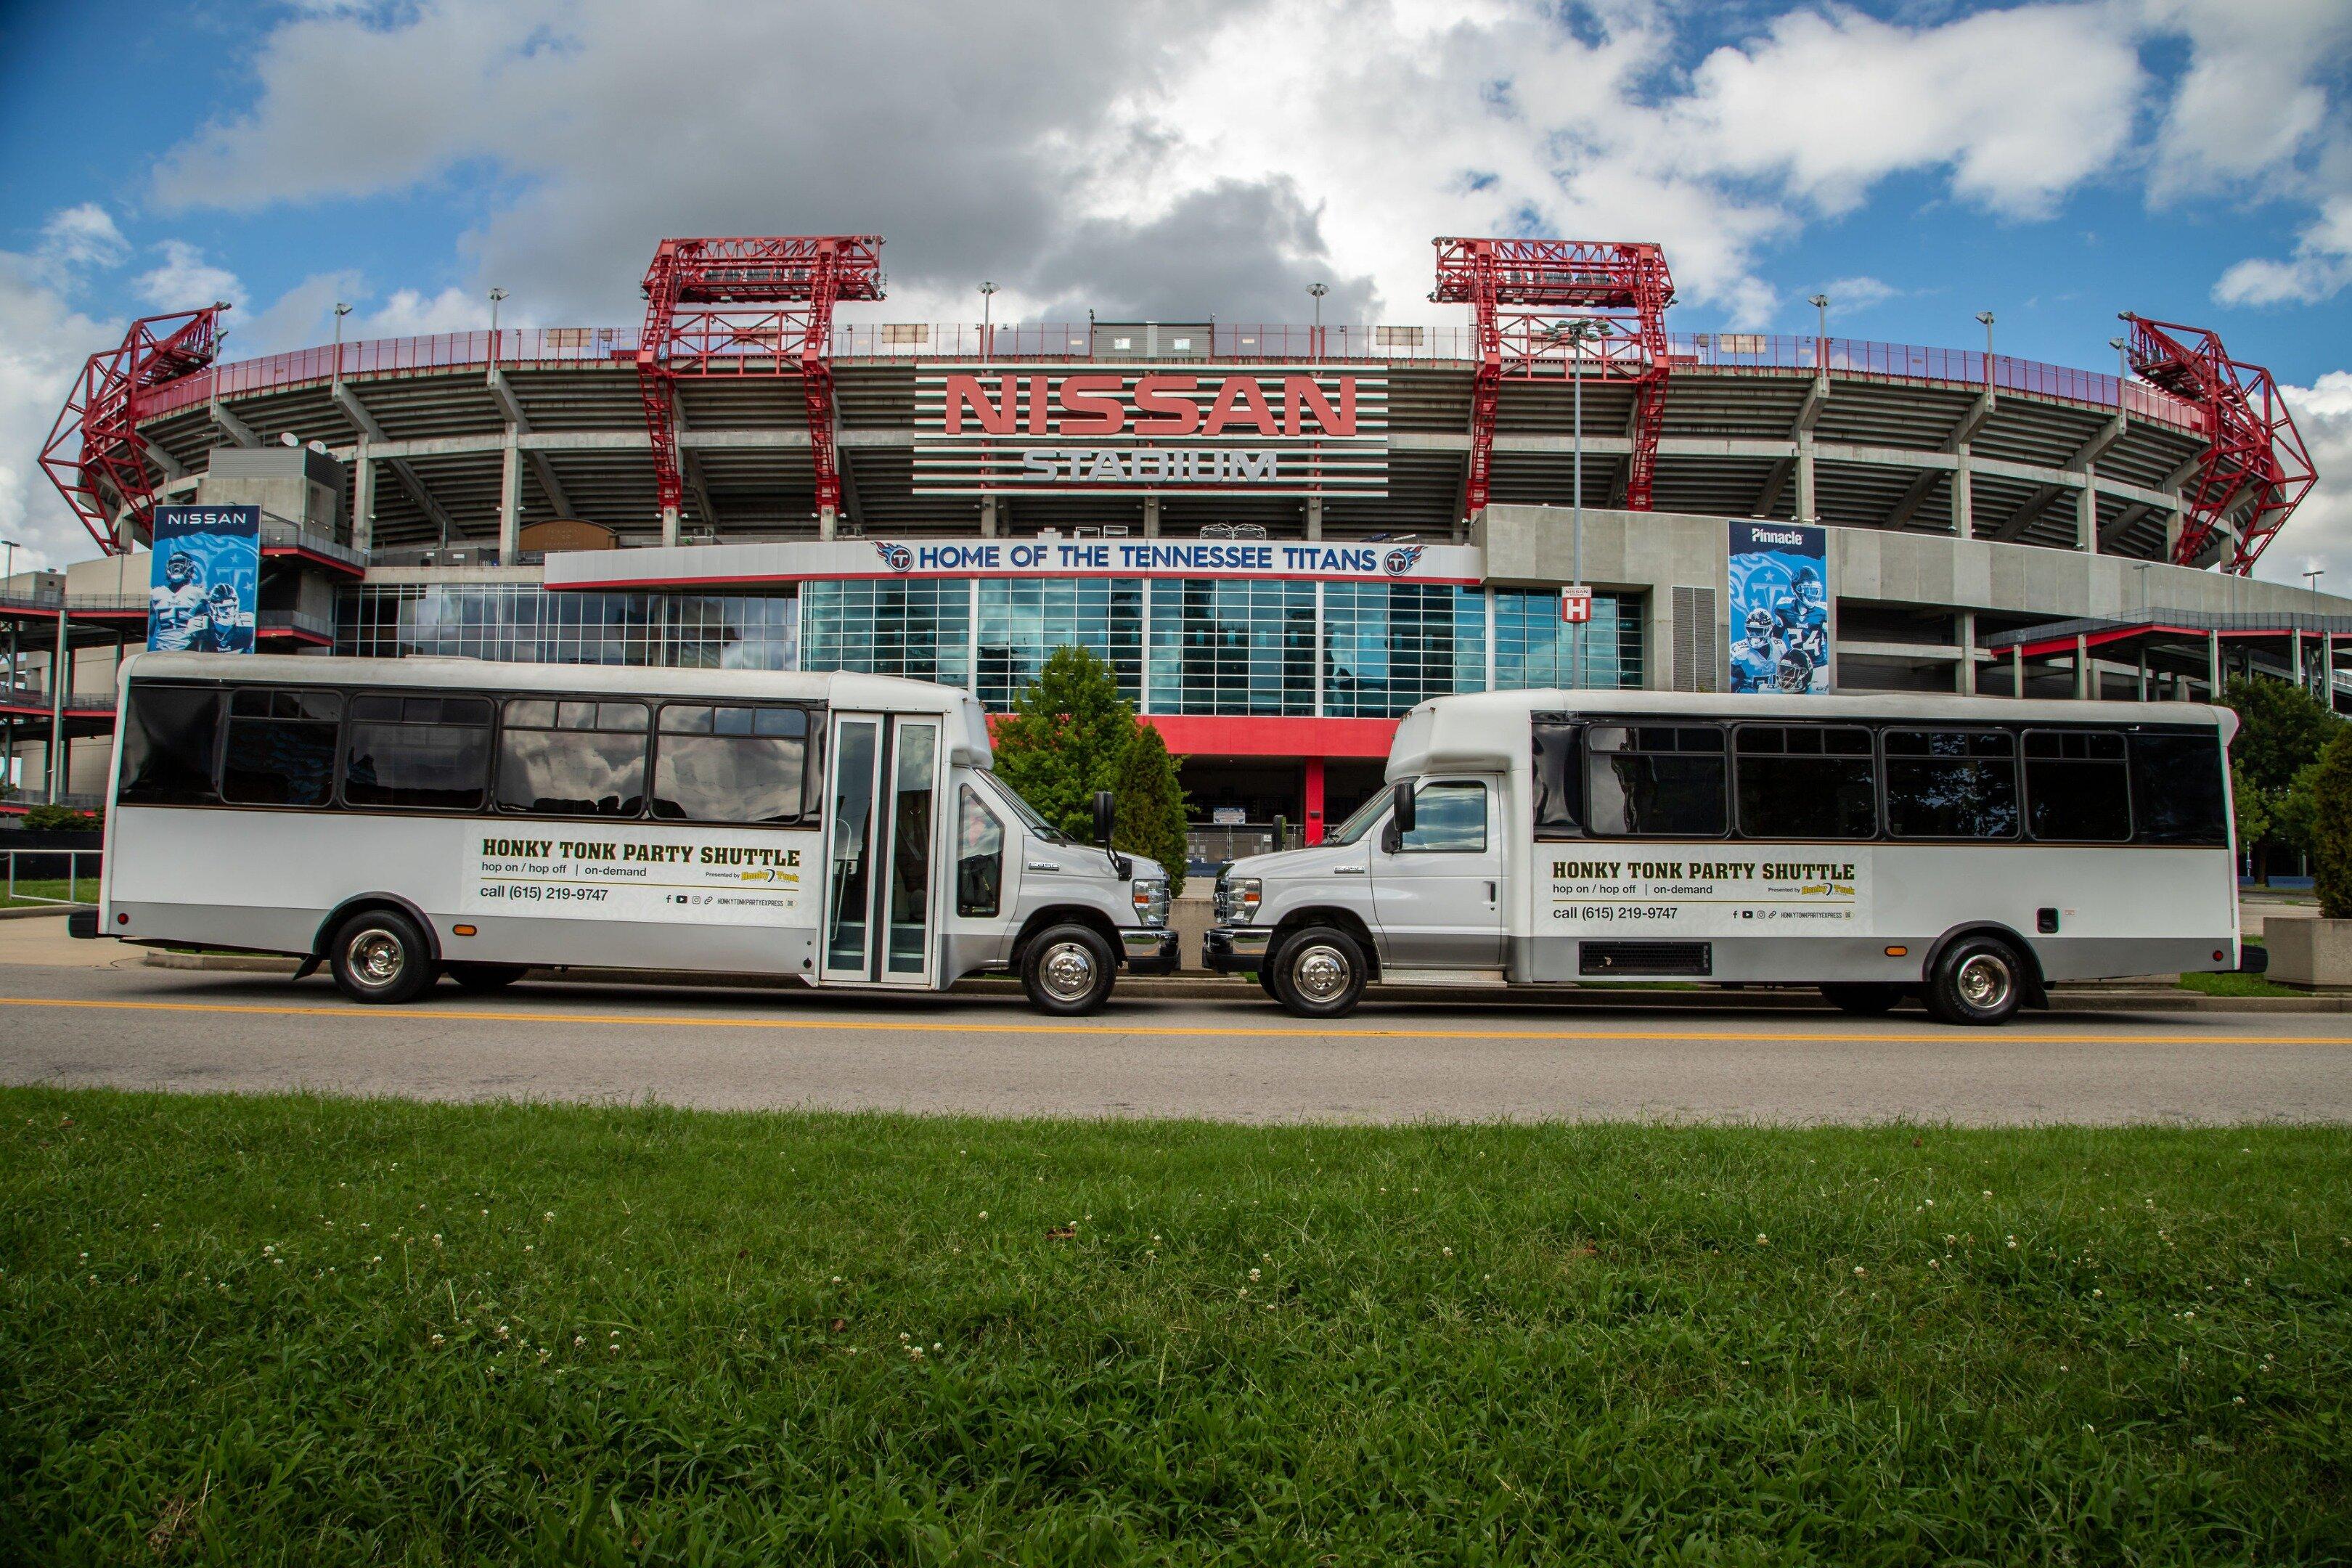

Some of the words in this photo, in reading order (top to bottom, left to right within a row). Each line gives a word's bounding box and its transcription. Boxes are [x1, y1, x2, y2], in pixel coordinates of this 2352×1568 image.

[946, 375, 1357, 436] NISSAN
[1021, 449, 1277, 483] STADIUM
[168, 513, 247, 525] NISSAN
[1752, 528, 1802, 546] Pinnacle
[919, 546, 1000, 568] HOME
[1010, 545, 1048, 568] OF
[1058, 545, 1109, 567] THE
[1120, 546, 1273, 568] TENNESSEE
[1283, 547, 1377, 571] TITANS
[1567, 599, 1587, 620] H
[1787, 627, 1821, 656] 24
[482, 838, 553, 858] HONKY
[559, 841, 617, 860] TONK
[623, 844, 694, 862] PARTY
[701, 846, 801, 867] SHUTTLE
[481, 862, 502, 872] hop
[528, 863, 549, 873] hop
[552, 864, 567, 873] off
[584, 867, 647, 877] on-demand
[1552, 861, 1621, 878] HONKY
[1627, 862, 1683, 880] TONK
[1689, 862, 1756, 880] PARTY
[1762, 862, 1855, 881] SHUTTLE
[481, 886, 505, 897] call
[510, 886, 542, 902] (615)
[546, 887, 609, 902] 219-9747
[1553, 884, 1573, 894] hop
[1599, 884, 1620, 895] hop
[1622, 885, 1637, 894] off
[1654, 885, 1713, 894] on-demand
[1802, 884, 1828, 895] Honky
[1834, 884, 1855, 895] Tonk
[717, 898, 784, 907] HONKYTONKPARTYEXPRESS
[1553, 907, 1577, 919] call
[1582, 907, 1614, 921] (615)
[1618, 907, 1678, 919] 219-9747
